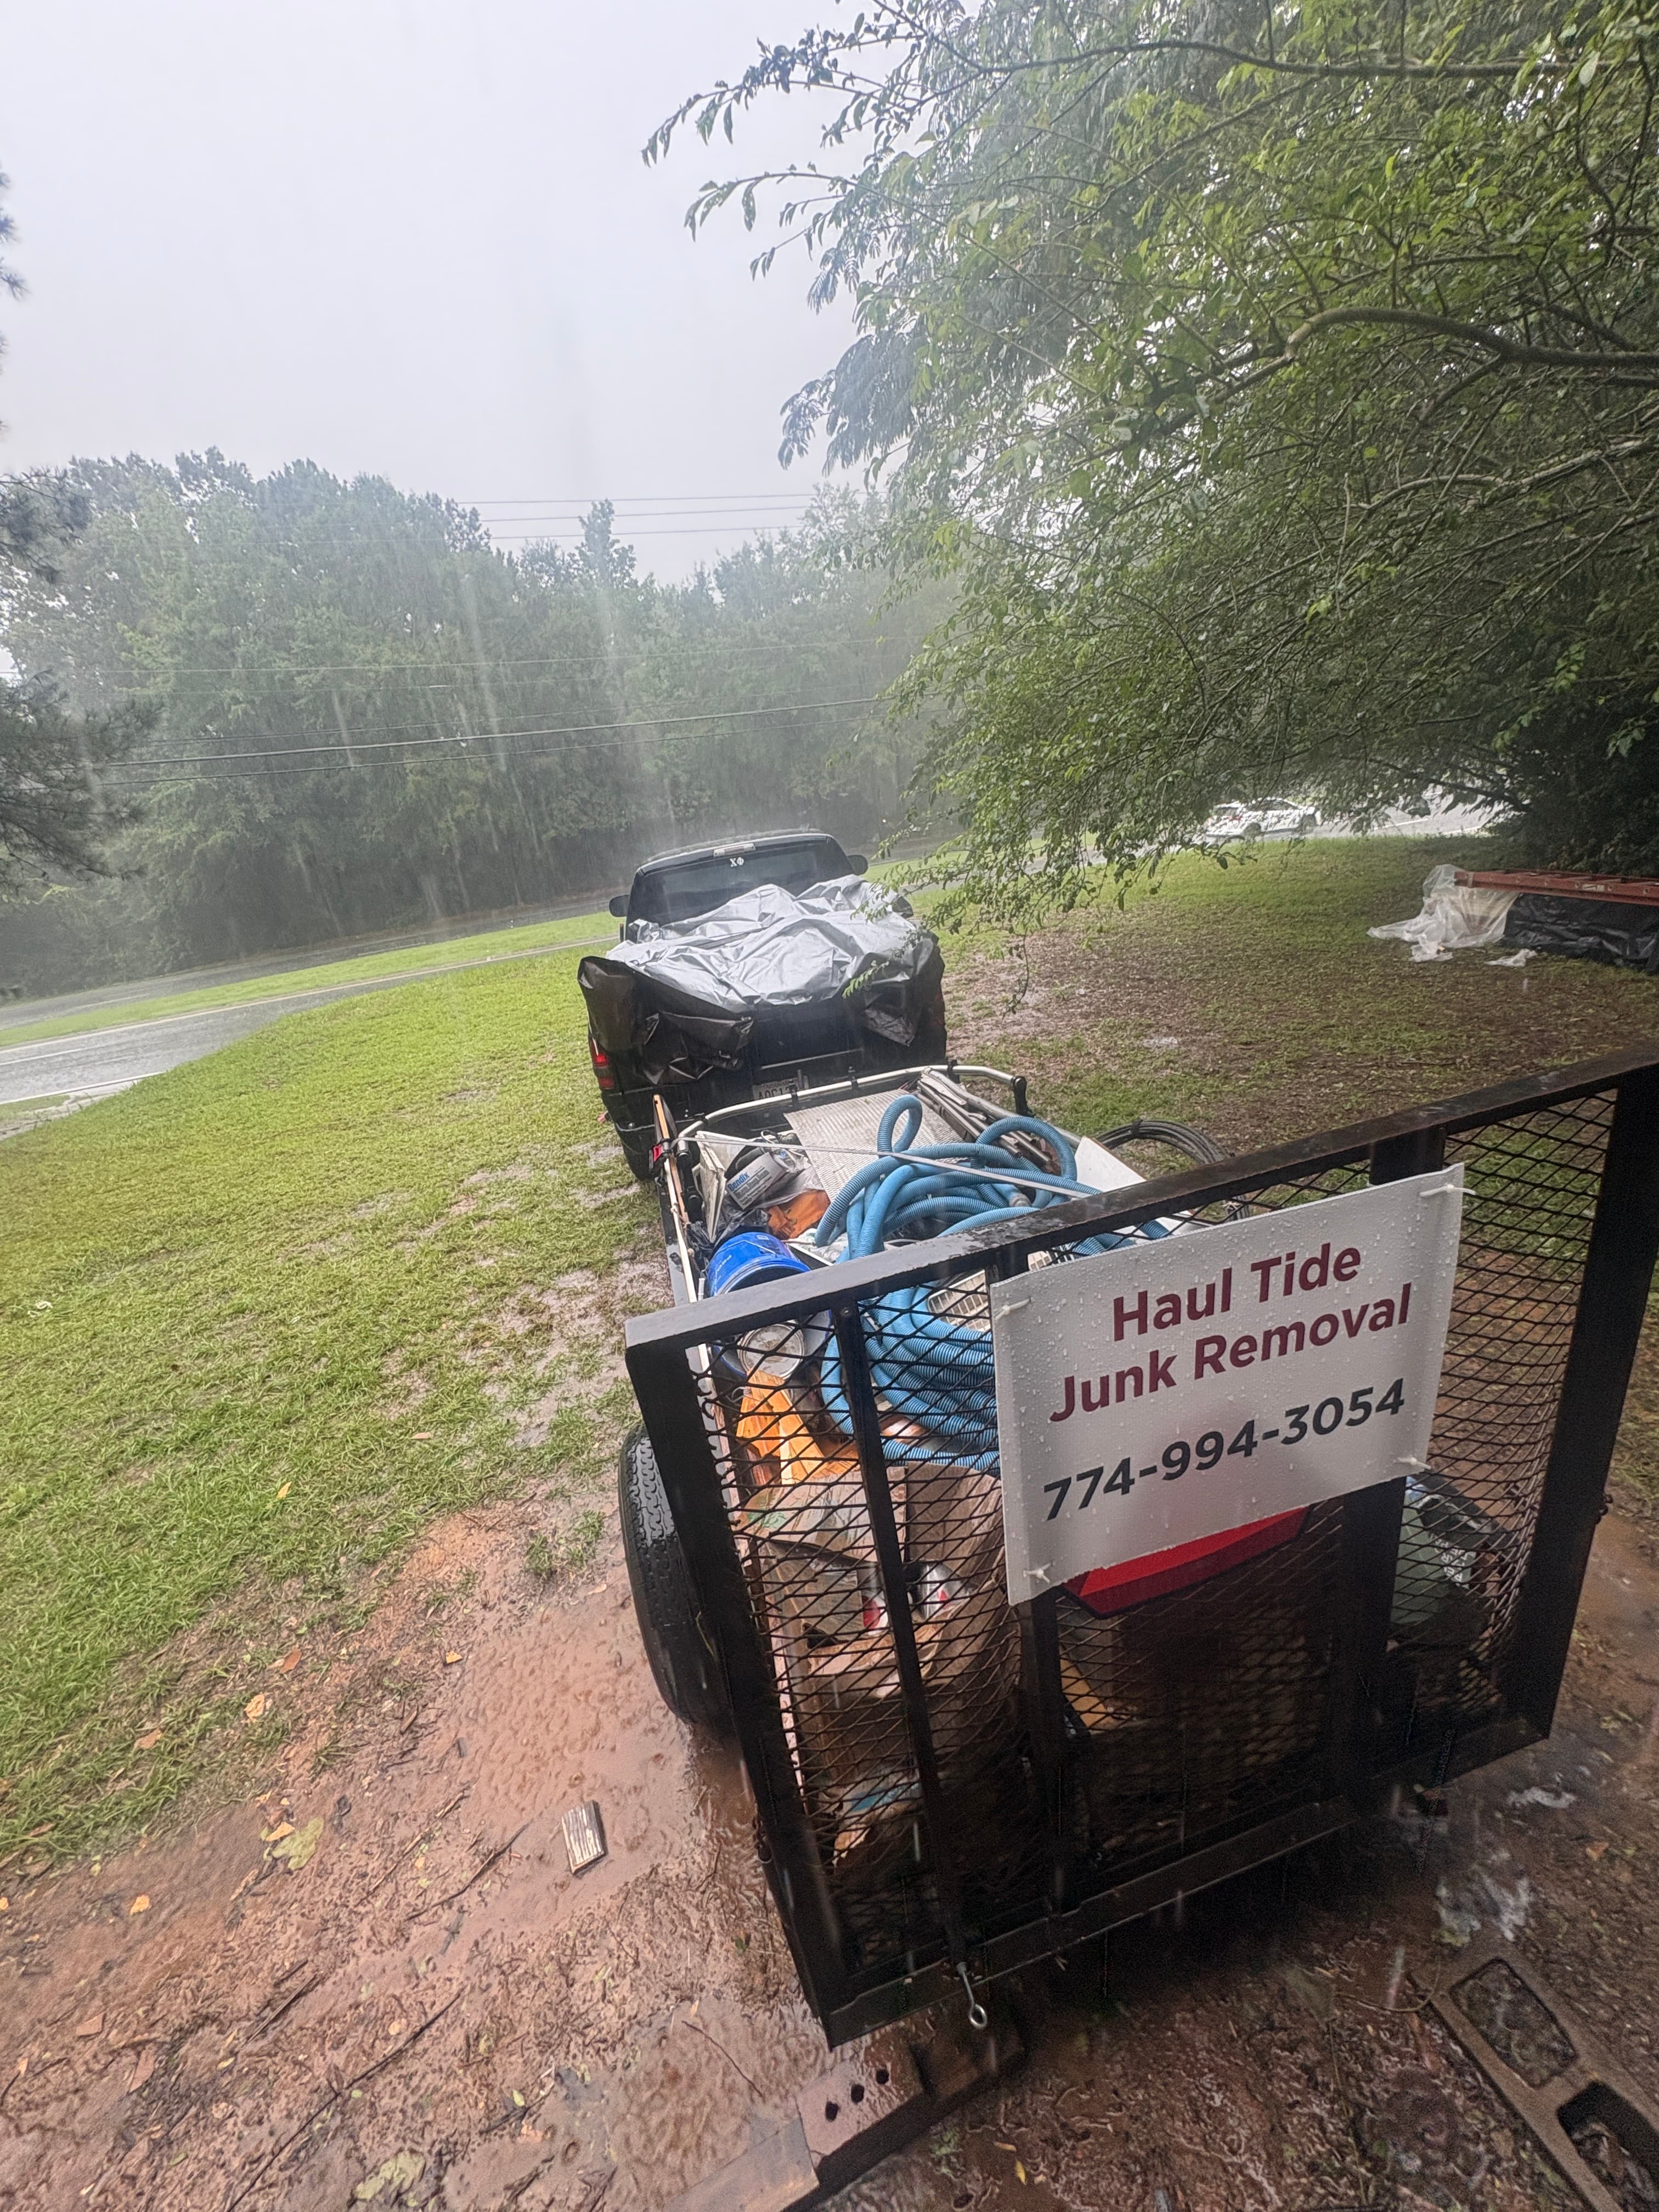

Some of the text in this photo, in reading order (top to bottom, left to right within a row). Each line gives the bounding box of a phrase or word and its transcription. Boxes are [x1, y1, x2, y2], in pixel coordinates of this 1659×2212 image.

[727, 1171, 749, 1192] Bendix
[1113, 1242, 1361, 1342] Haul Tide
[1049, 1282, 1412, 1423] Junk Removal
[1043, 1378, 1405, 1522] 774-994-3054
